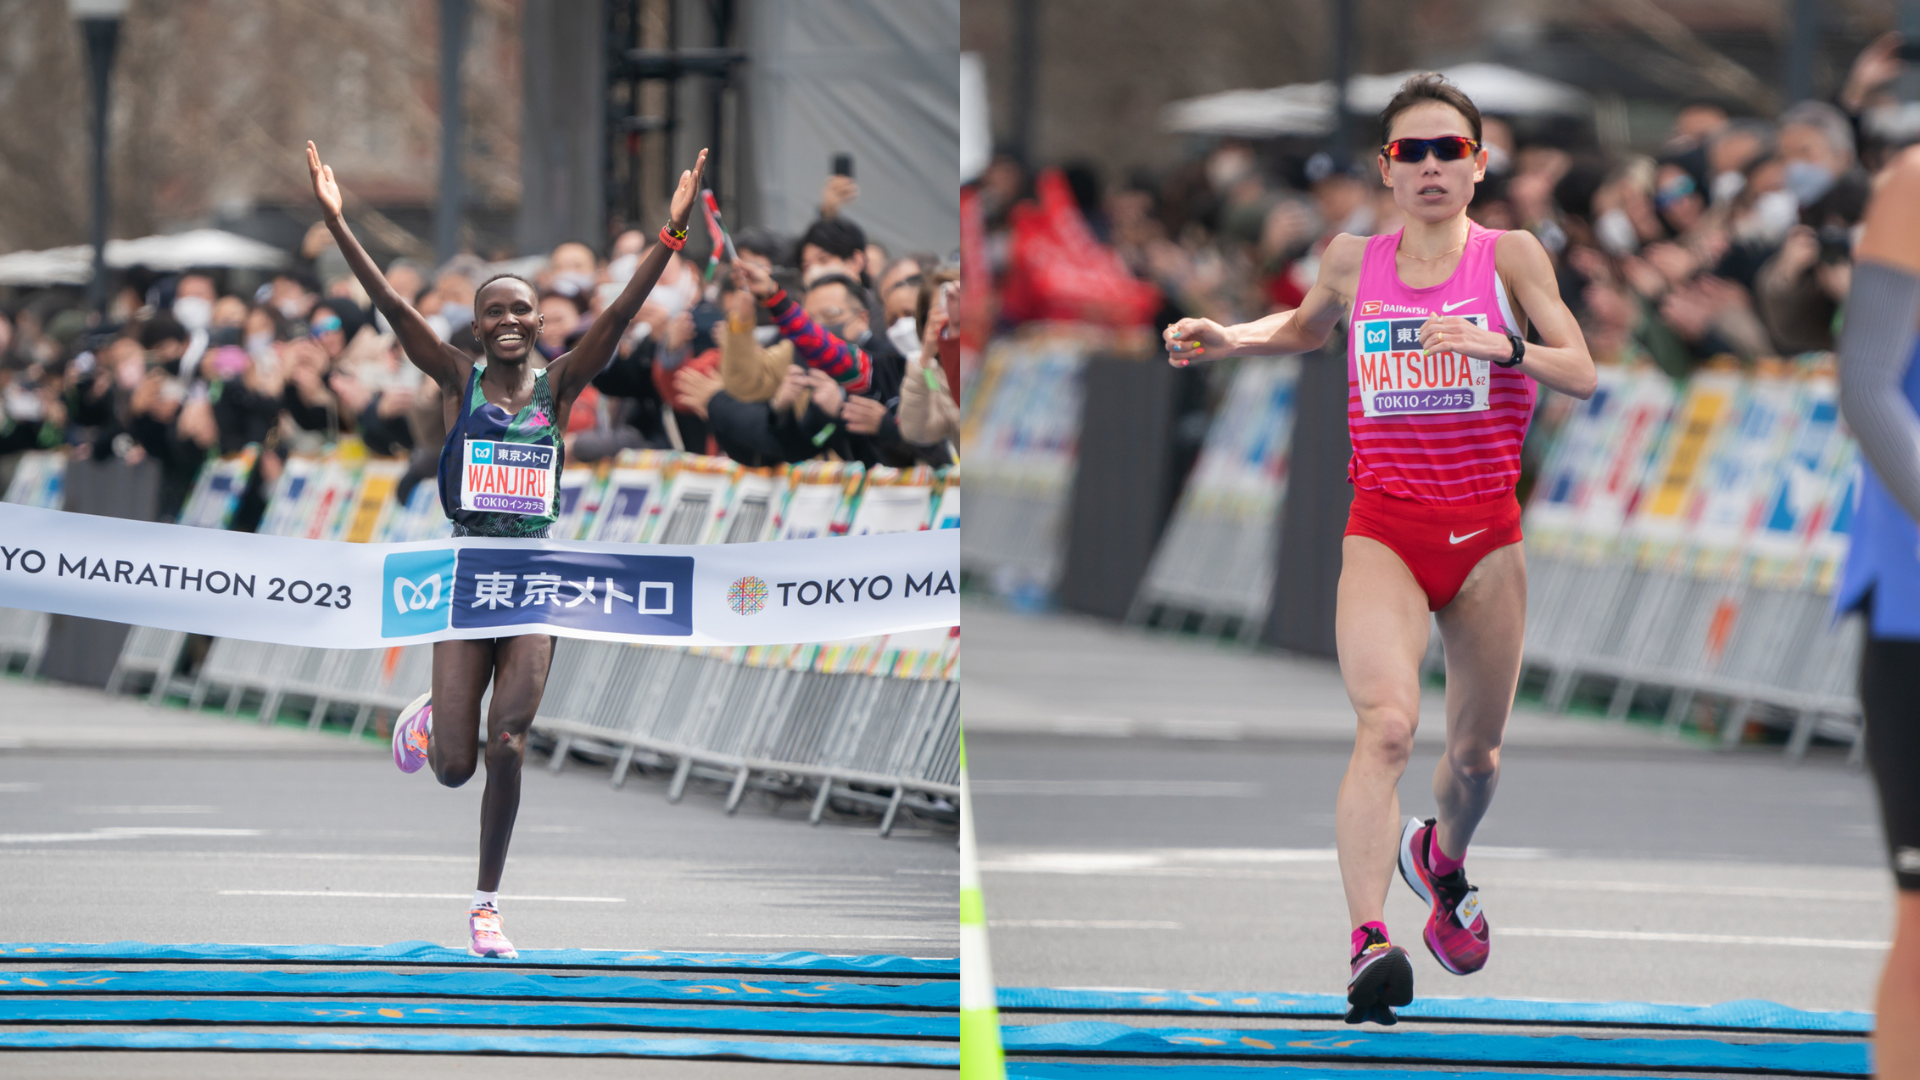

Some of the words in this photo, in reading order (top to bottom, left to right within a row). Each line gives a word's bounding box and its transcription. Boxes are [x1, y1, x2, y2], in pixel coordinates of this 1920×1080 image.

[1383, 304, 1428, 315] DAIHATSU
[1360, 351, 1473, 392] MATSUDA
[498, 449, 550, 464] 東京メトロ
[468, 465, 546, 497] WANJIRU
[0, 545, 46, 574] YO
[58, 553, 256, 598] MARATHON
[267, 577, 352, 610] 2023
[471, 571, 674, 615] 東京メトロ
[776, 575, 893, 607] TOKYO
[904, 569, 960, 598] MA
